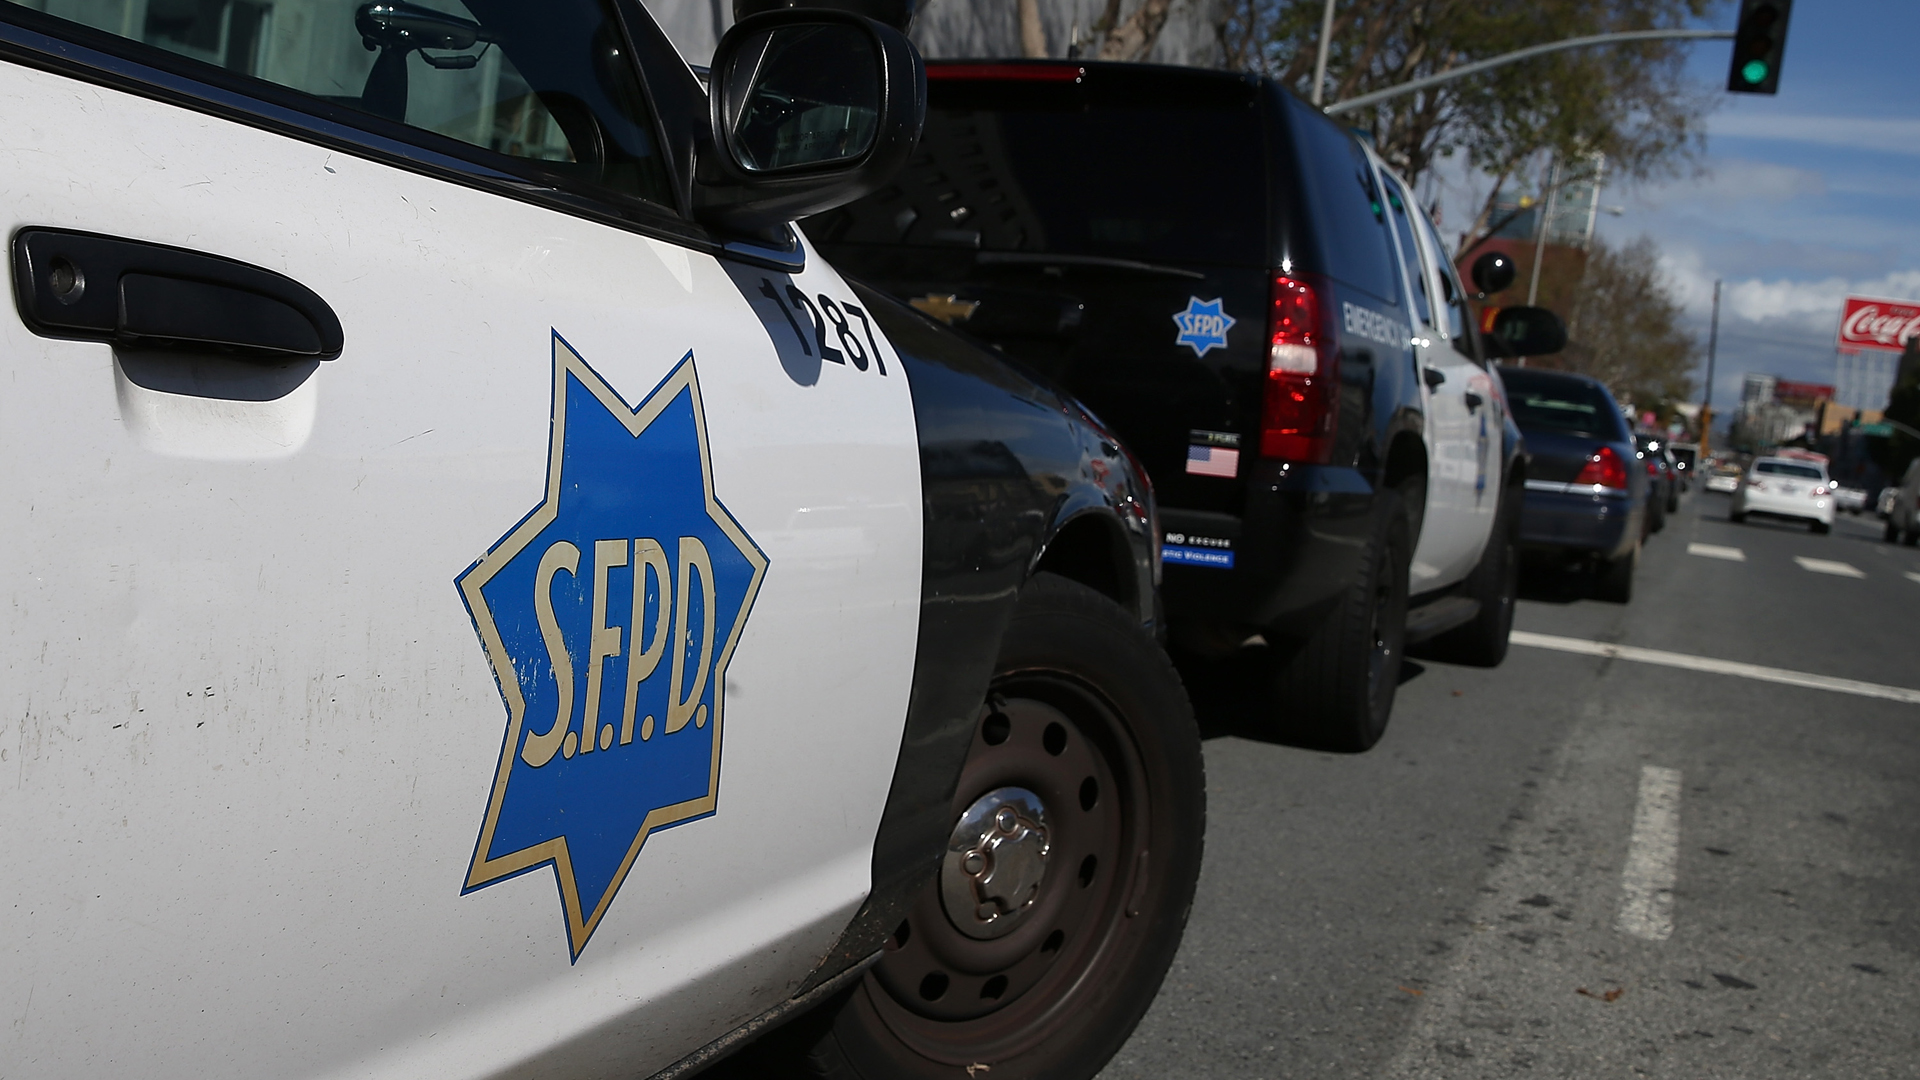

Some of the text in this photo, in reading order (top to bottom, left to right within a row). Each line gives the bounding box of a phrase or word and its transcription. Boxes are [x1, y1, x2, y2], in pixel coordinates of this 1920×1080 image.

[758, 277, 888, 377] 1287
[1165, 532, 1186, 545] NO
[520, 536, 716, 769] S.F.P.D.
